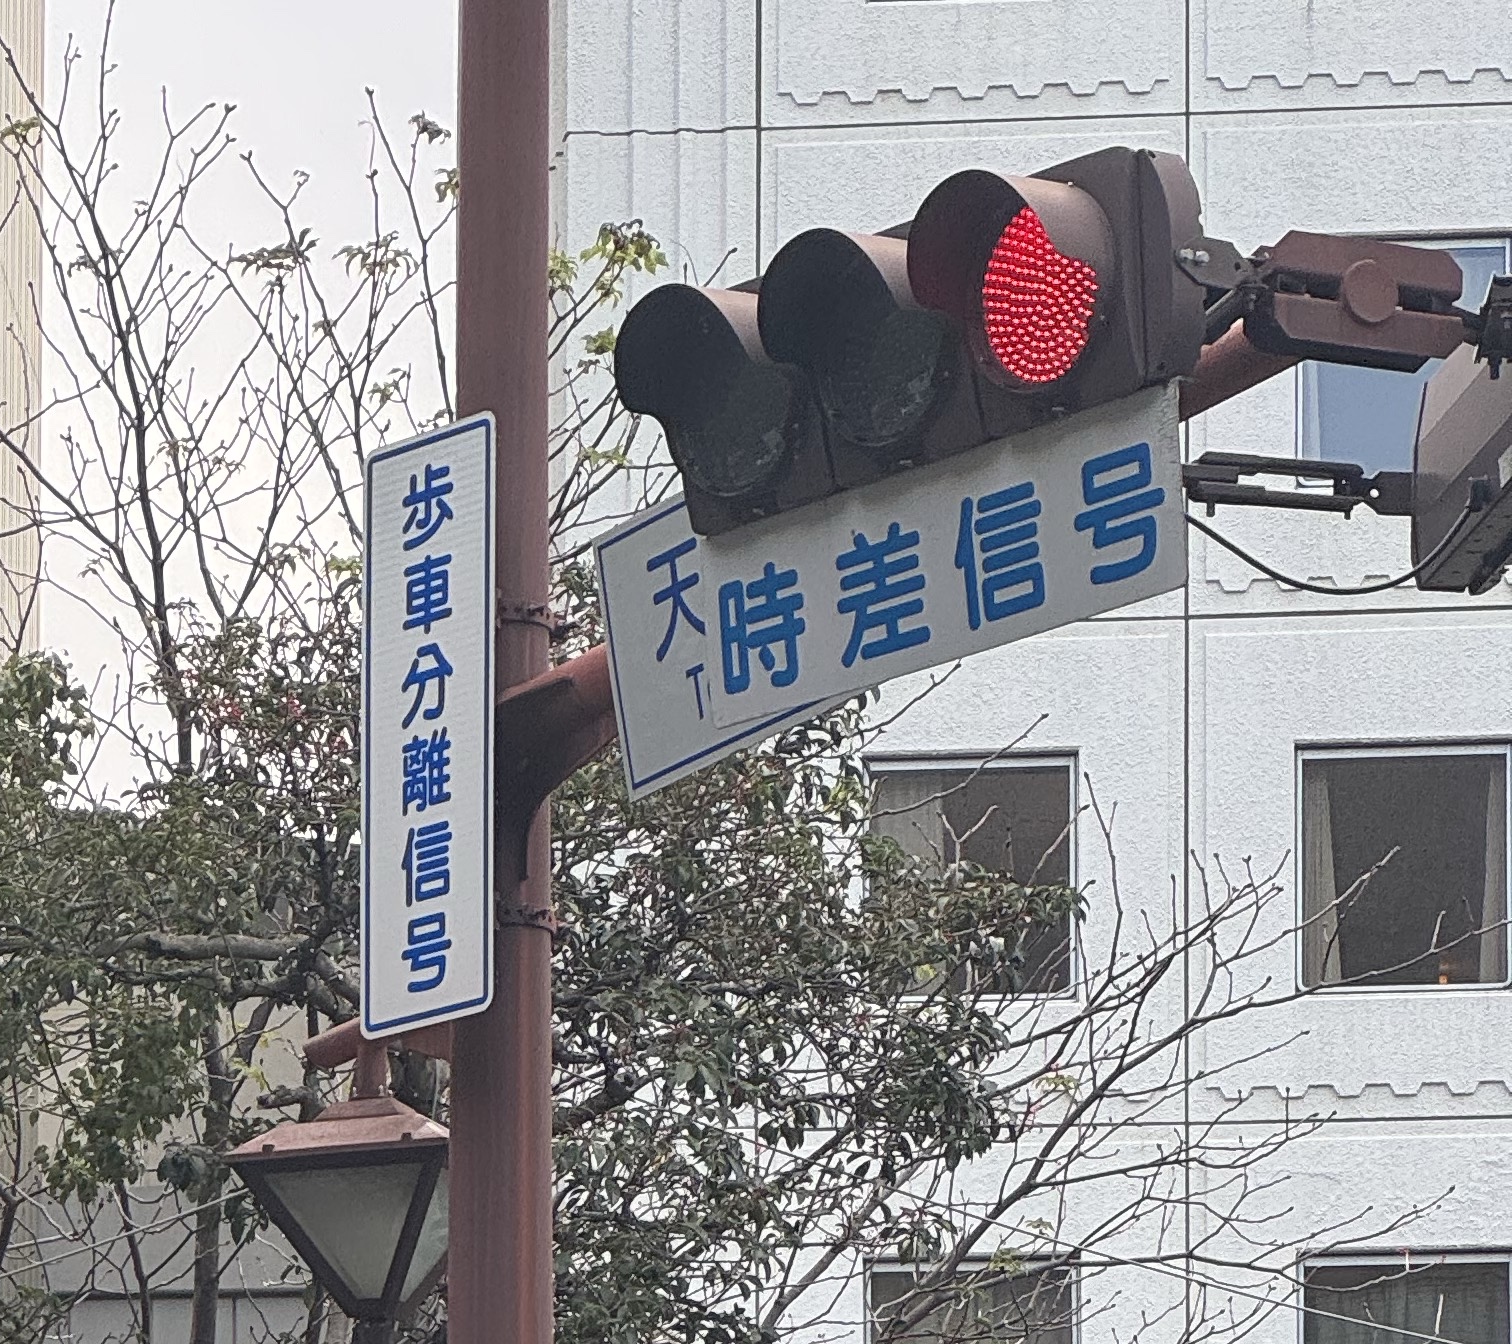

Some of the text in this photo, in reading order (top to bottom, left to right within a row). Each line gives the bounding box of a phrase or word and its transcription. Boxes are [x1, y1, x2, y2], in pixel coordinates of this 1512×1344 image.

[402, 463, 453, 993] 歩車分離信号
[718, 442, 1166, 695] 時差信号
